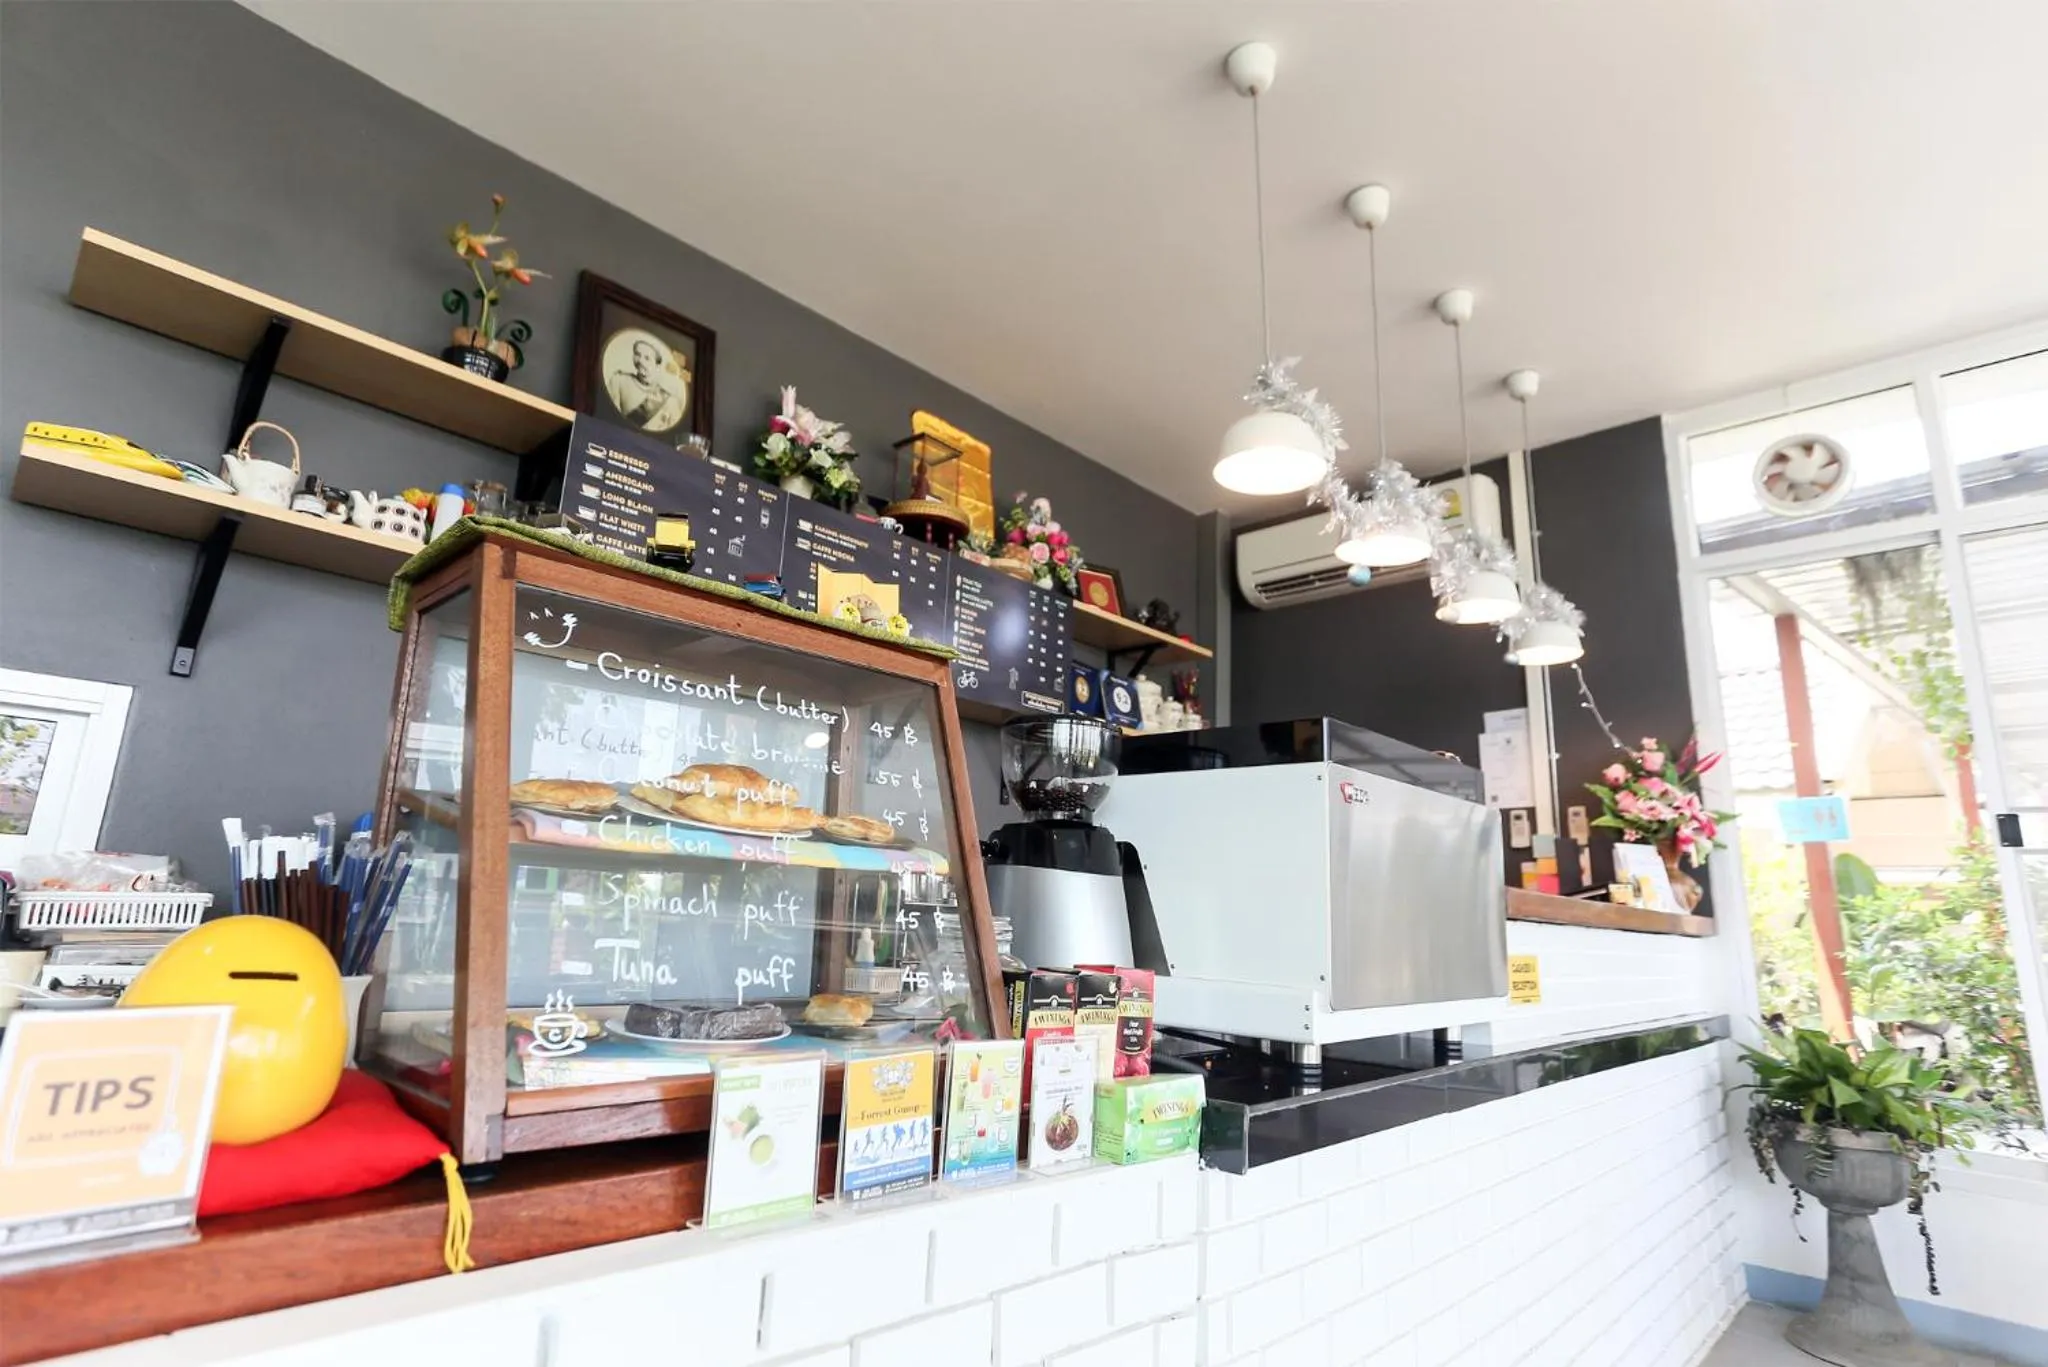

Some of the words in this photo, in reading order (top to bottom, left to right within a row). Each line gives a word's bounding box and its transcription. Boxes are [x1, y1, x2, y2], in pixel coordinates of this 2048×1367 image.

[608, 449, 650, 471] ESPRESSO
[605, 471, 655, 493] AMERICANO
[599, 512, 618, 524] FLAT
[597, 651, 744, 706] Croissant
[757, 685, 850, 732] (butter)
[869, 721, 895, 740] 45
[875, 770, 902, 788] 55
[737, 778, 794, 817] puff
[882, 809, 907, 828] 45
[597, 815, 711, 855] Chicken
[739, 831, 812, 872] puff
[599, 874, 717, 931] Spinach
[743, 892, 802, 941] puff
[895, 908, 921, 930] 45
[594, 937, 678, 986] Tuna
[734, 954, 795, 1005] puff
[901, 965, 929, 991] 45
[1034, 1013, 1072, 1027] TWININGS
[1080, 1009, 1116, 1023] TWININGS
[43, 1075, 156, 1117] TIPS
[1152, 1101, 1190, 1120] TWININGS
